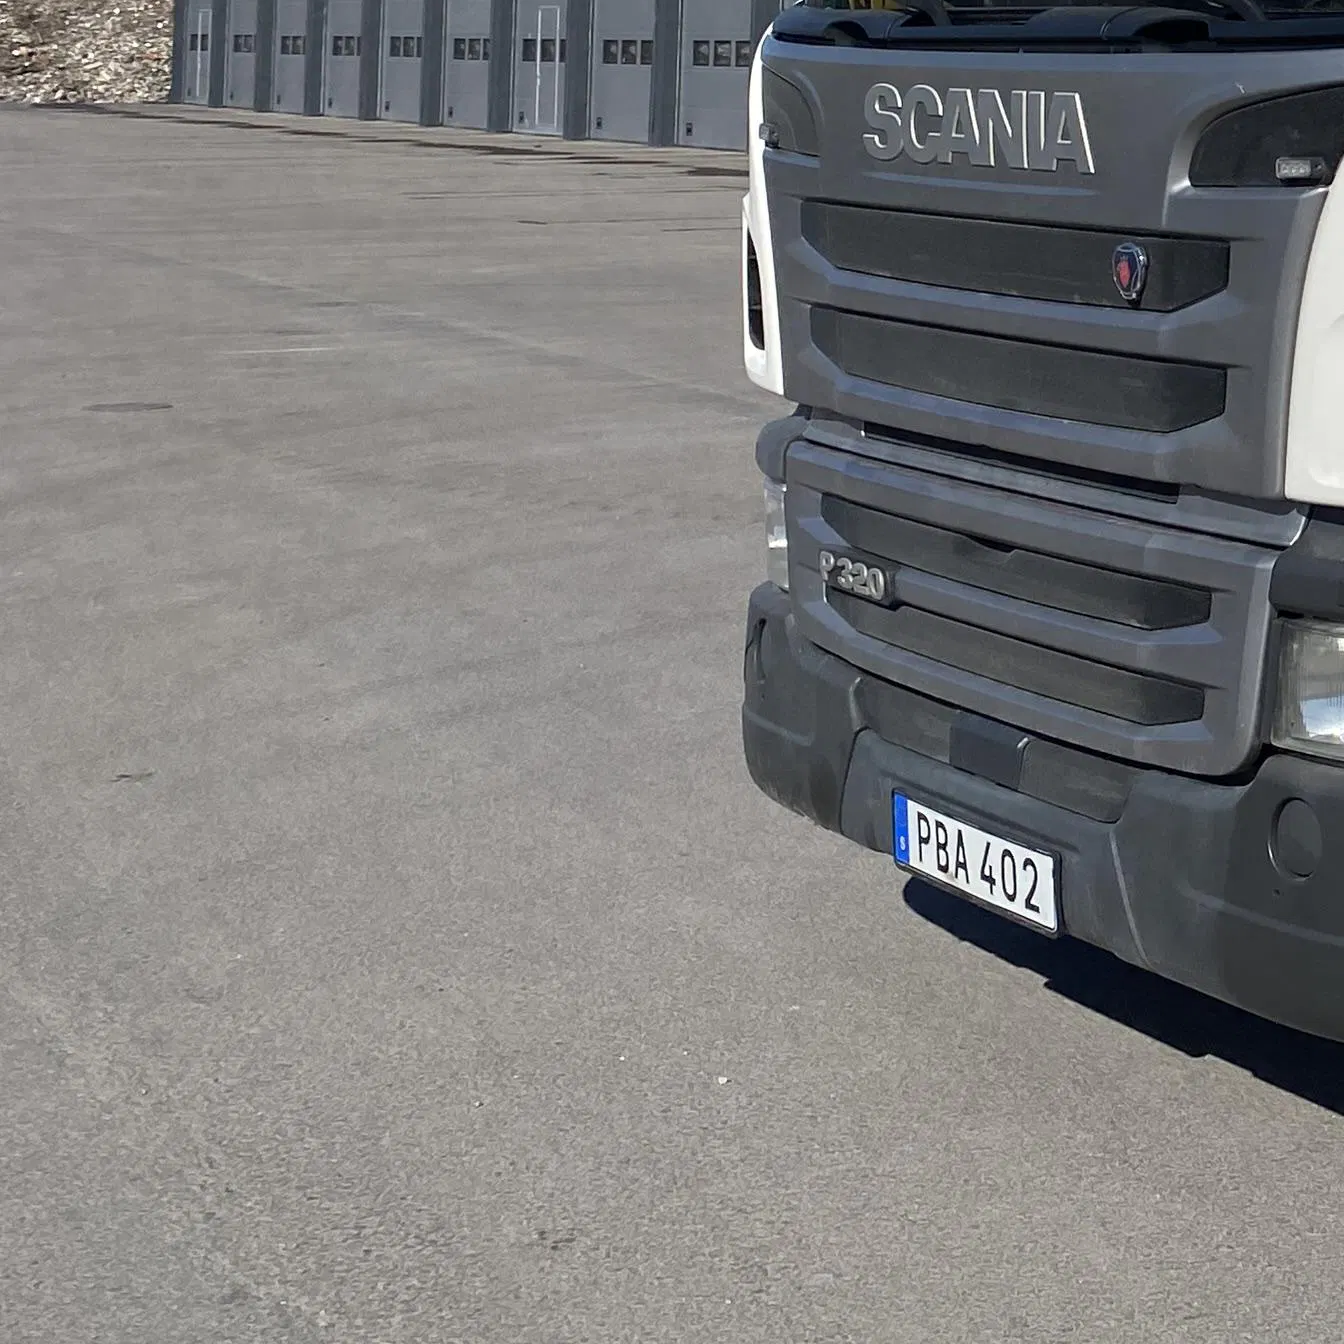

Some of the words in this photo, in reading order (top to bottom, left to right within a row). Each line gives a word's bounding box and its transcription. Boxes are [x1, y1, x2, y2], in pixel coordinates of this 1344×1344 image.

[863, 82, 1096, 175] SCANIA
[820, 550, 836, 581] P
[836, 557, 885, 601] 320
[900, 835, 906, 851] S
[917, 811, 970, 884] PBA
[980, 841, 1040, 914] 402
